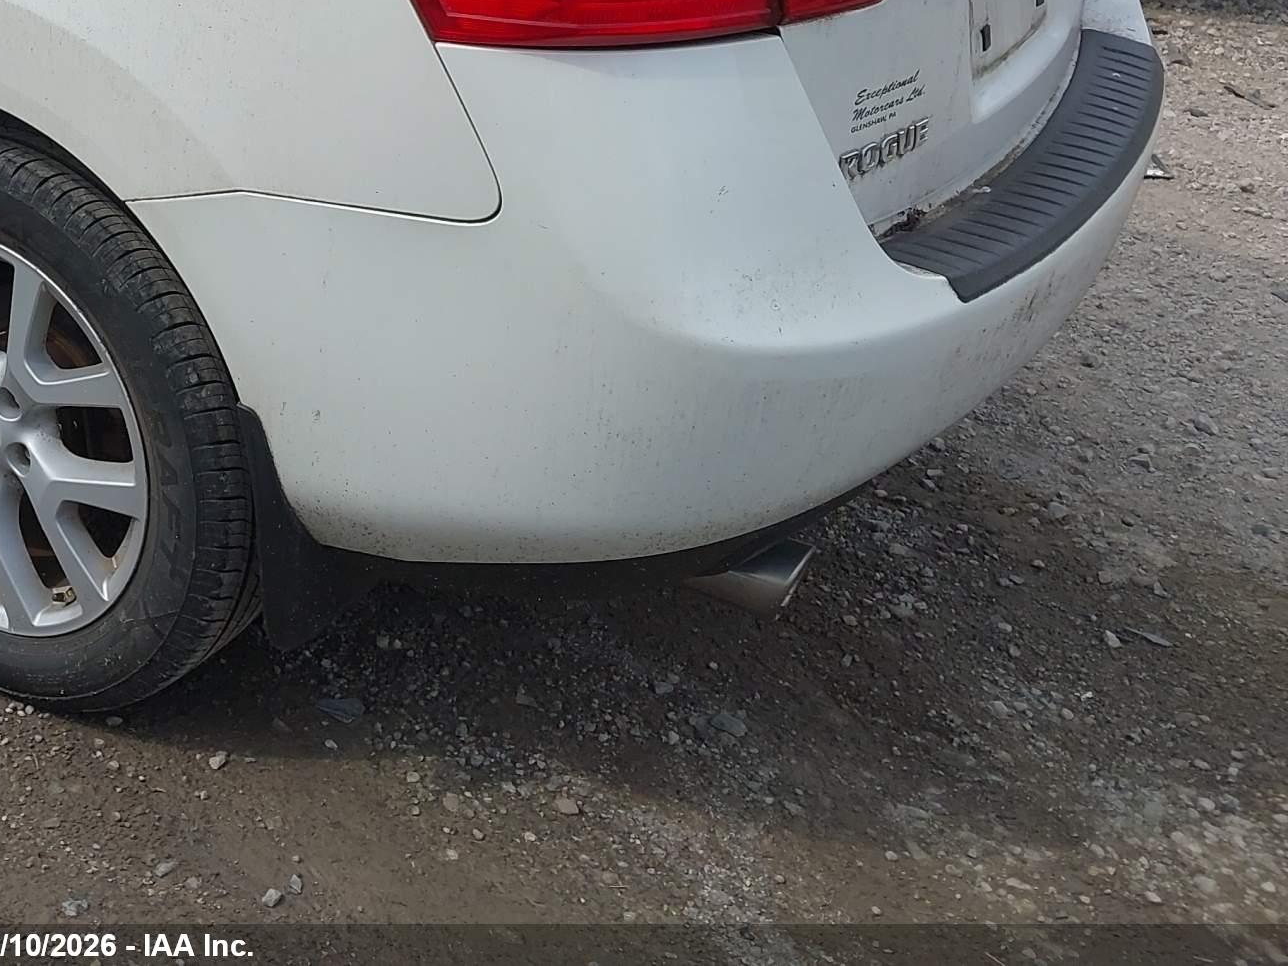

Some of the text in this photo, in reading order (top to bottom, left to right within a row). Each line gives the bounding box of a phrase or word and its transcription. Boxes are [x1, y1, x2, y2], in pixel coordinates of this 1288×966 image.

[854, 69, 920, 106] Exceptional
[852, 97, 904, 121] Motorcars
[888, 111, 897, 119] PA
[838, 117, 929, 181] ROGUE
